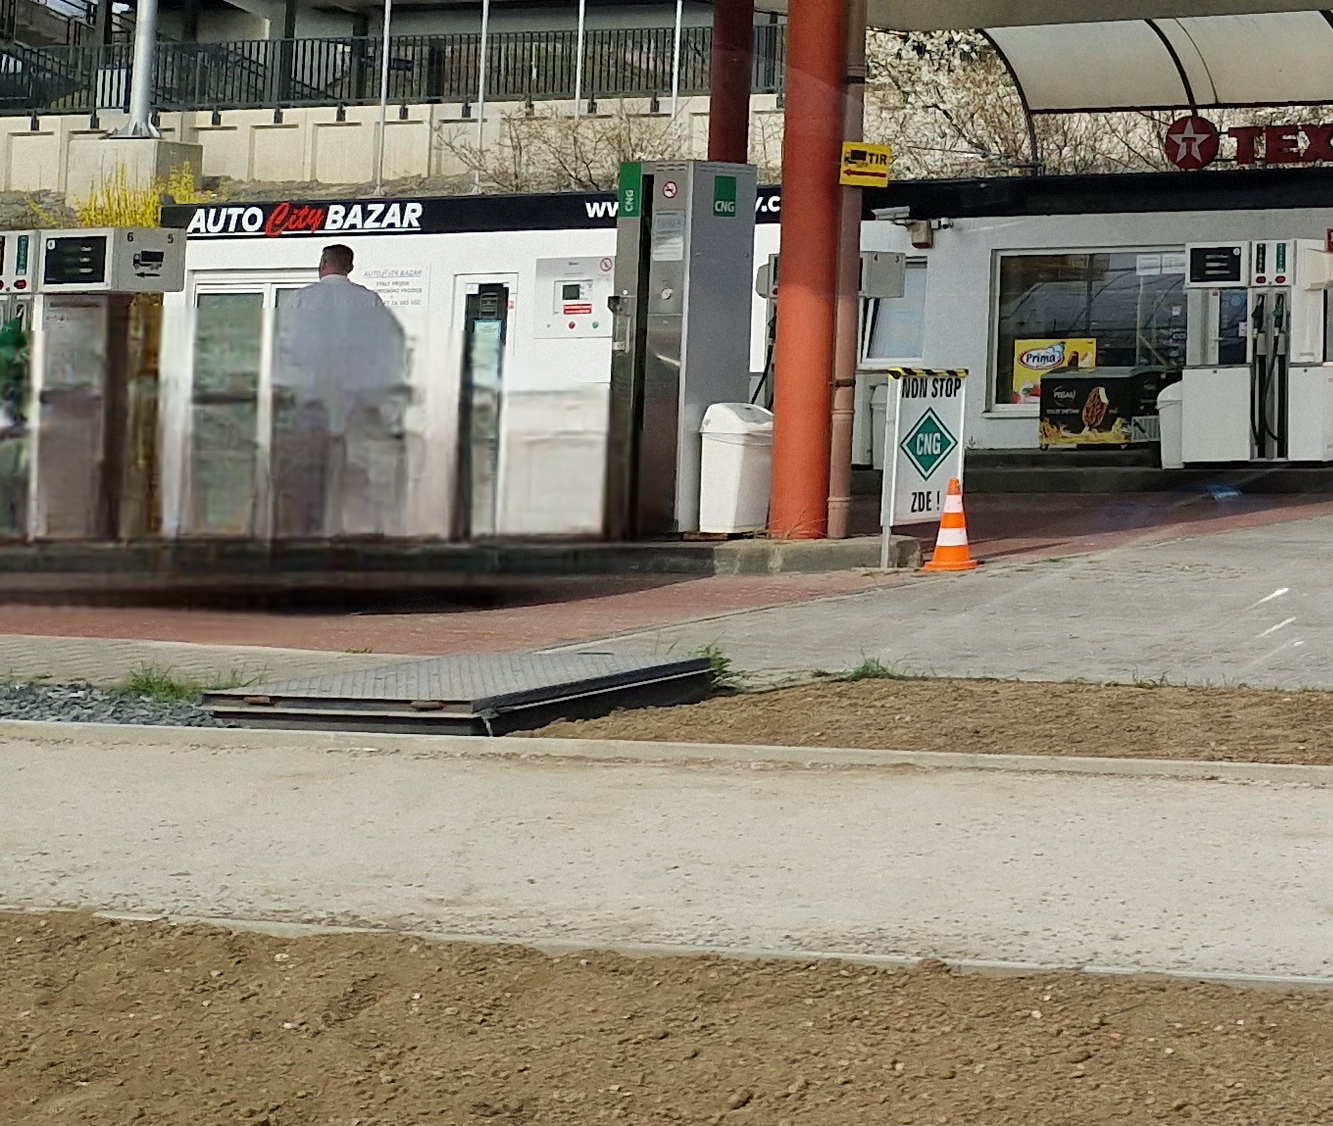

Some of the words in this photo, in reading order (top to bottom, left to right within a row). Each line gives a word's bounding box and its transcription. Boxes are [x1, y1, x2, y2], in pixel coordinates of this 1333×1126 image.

[868, 153, 888, 165] TIR
[625, 190, 635, 213] CNG
[714, 200, 736, 213] CNG
[187, 206, 264, 233] AUTO
[264, 202, 327, 237] City
[325, 202, 424, 230] BAZAR
[127, 232, 134, 243] 6
[167, 233, 174, 244] 5
[1026, 353, 1056, 363] Prima
[902, 377, 928, 398] NON
[931, 377, 962, 398] STOP
[916, 432, 941, 456] CNG
[911, 491, 932, 512] ZDE
